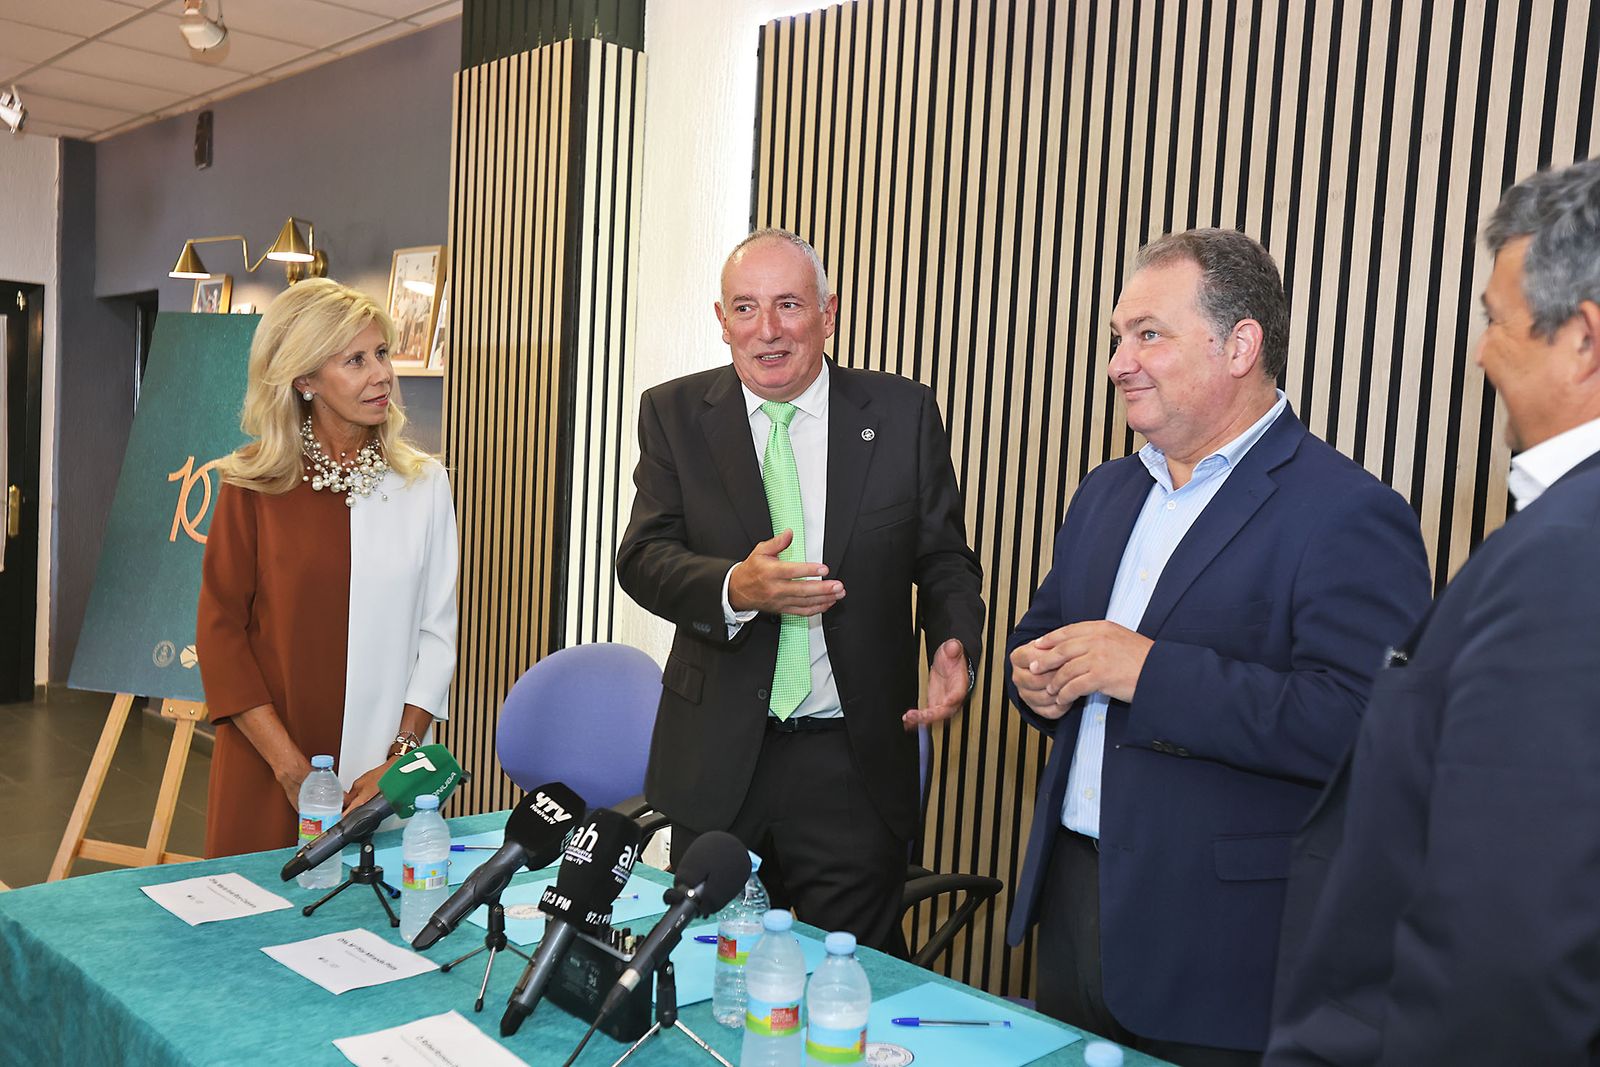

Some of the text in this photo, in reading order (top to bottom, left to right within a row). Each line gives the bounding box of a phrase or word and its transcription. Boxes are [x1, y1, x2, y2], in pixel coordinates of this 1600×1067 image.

[407, 771, 457, 810] TONUBA
[569, 822, 599, 852] ah
[555, 895, 572, 911] FM
